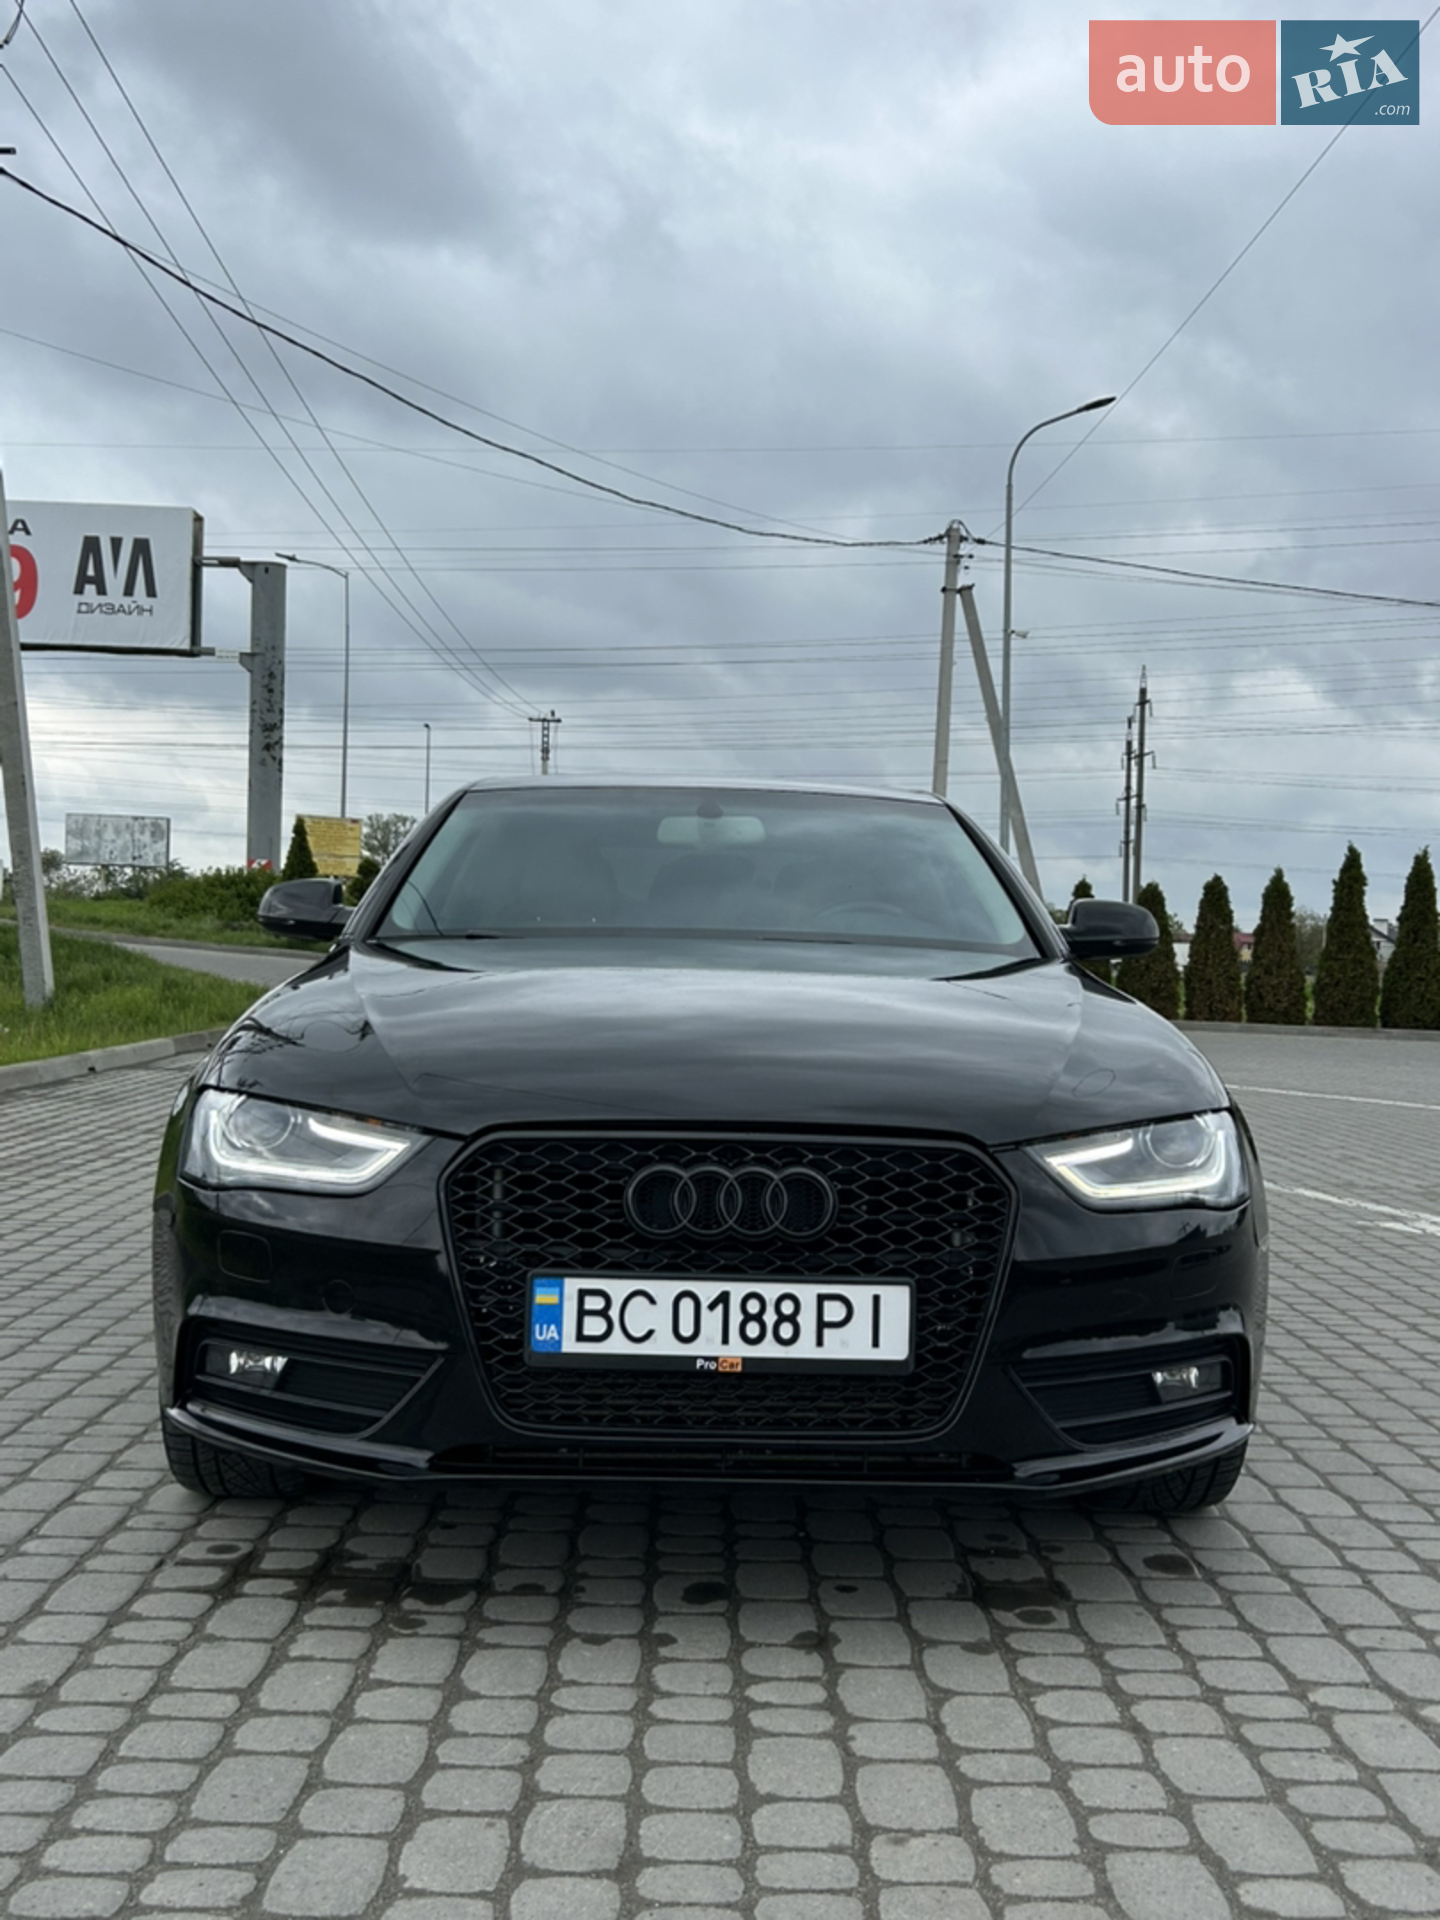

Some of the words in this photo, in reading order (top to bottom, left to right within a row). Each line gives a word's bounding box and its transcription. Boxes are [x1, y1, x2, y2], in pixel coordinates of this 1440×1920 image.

[76, 600, 154, 616] ДИЗАЙН
[575, 1287, 658, 1344] BC
[671, 1289, 802, 1347] 0188
[815, 1292, 882, 1348] PI
[535, 1323, 559, 1341] UA
